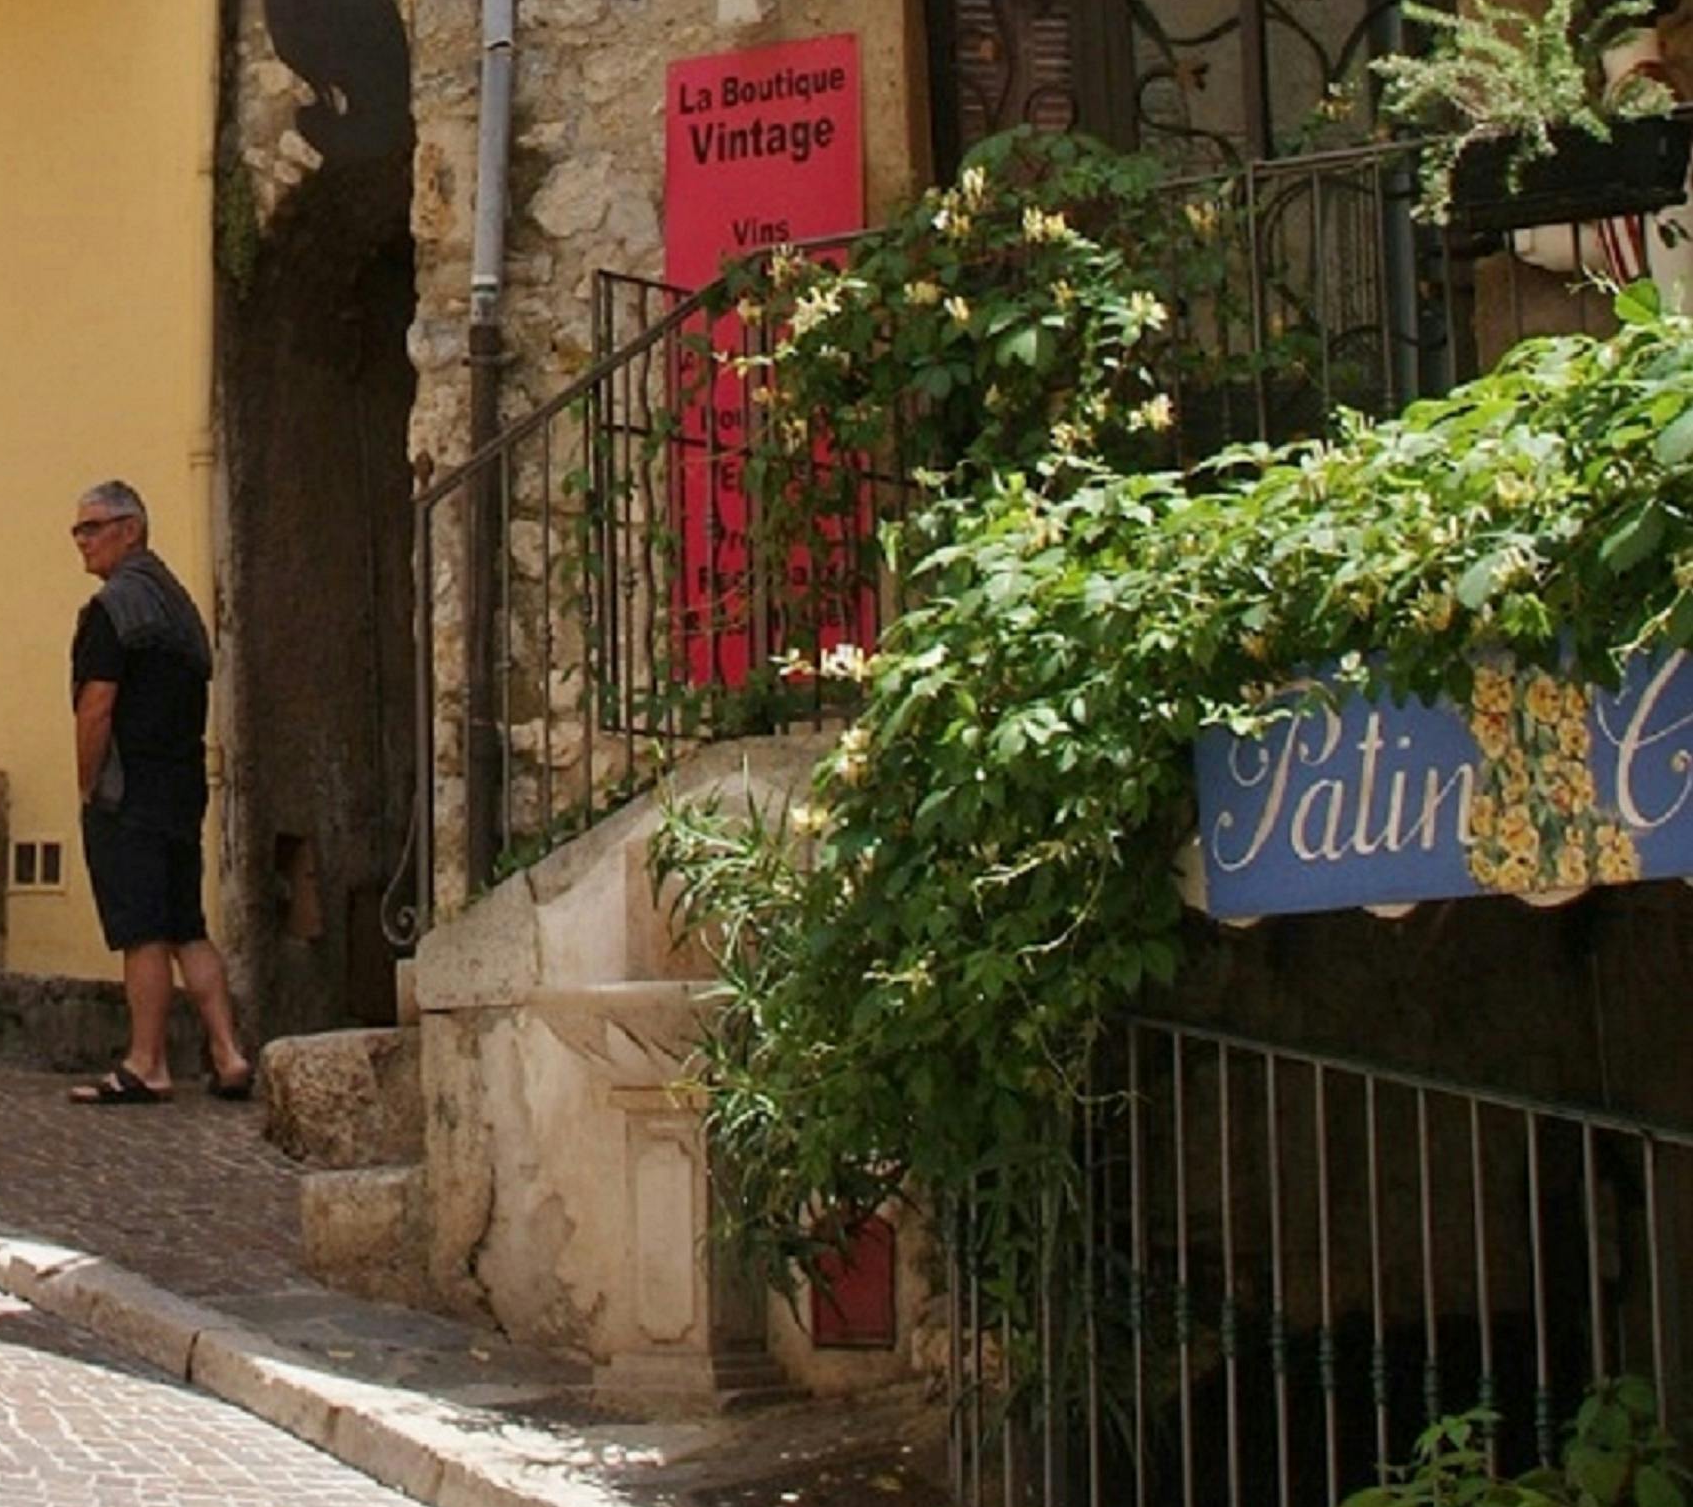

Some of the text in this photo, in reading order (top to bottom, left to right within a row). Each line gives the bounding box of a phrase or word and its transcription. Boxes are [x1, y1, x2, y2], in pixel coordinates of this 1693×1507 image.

[678, 66, 847, 115] La Boutique
[689, 116, 836, 165] Vintage
[733, 217, 791, 246] Vins
[1211, 676, 1477, 874] Patin
